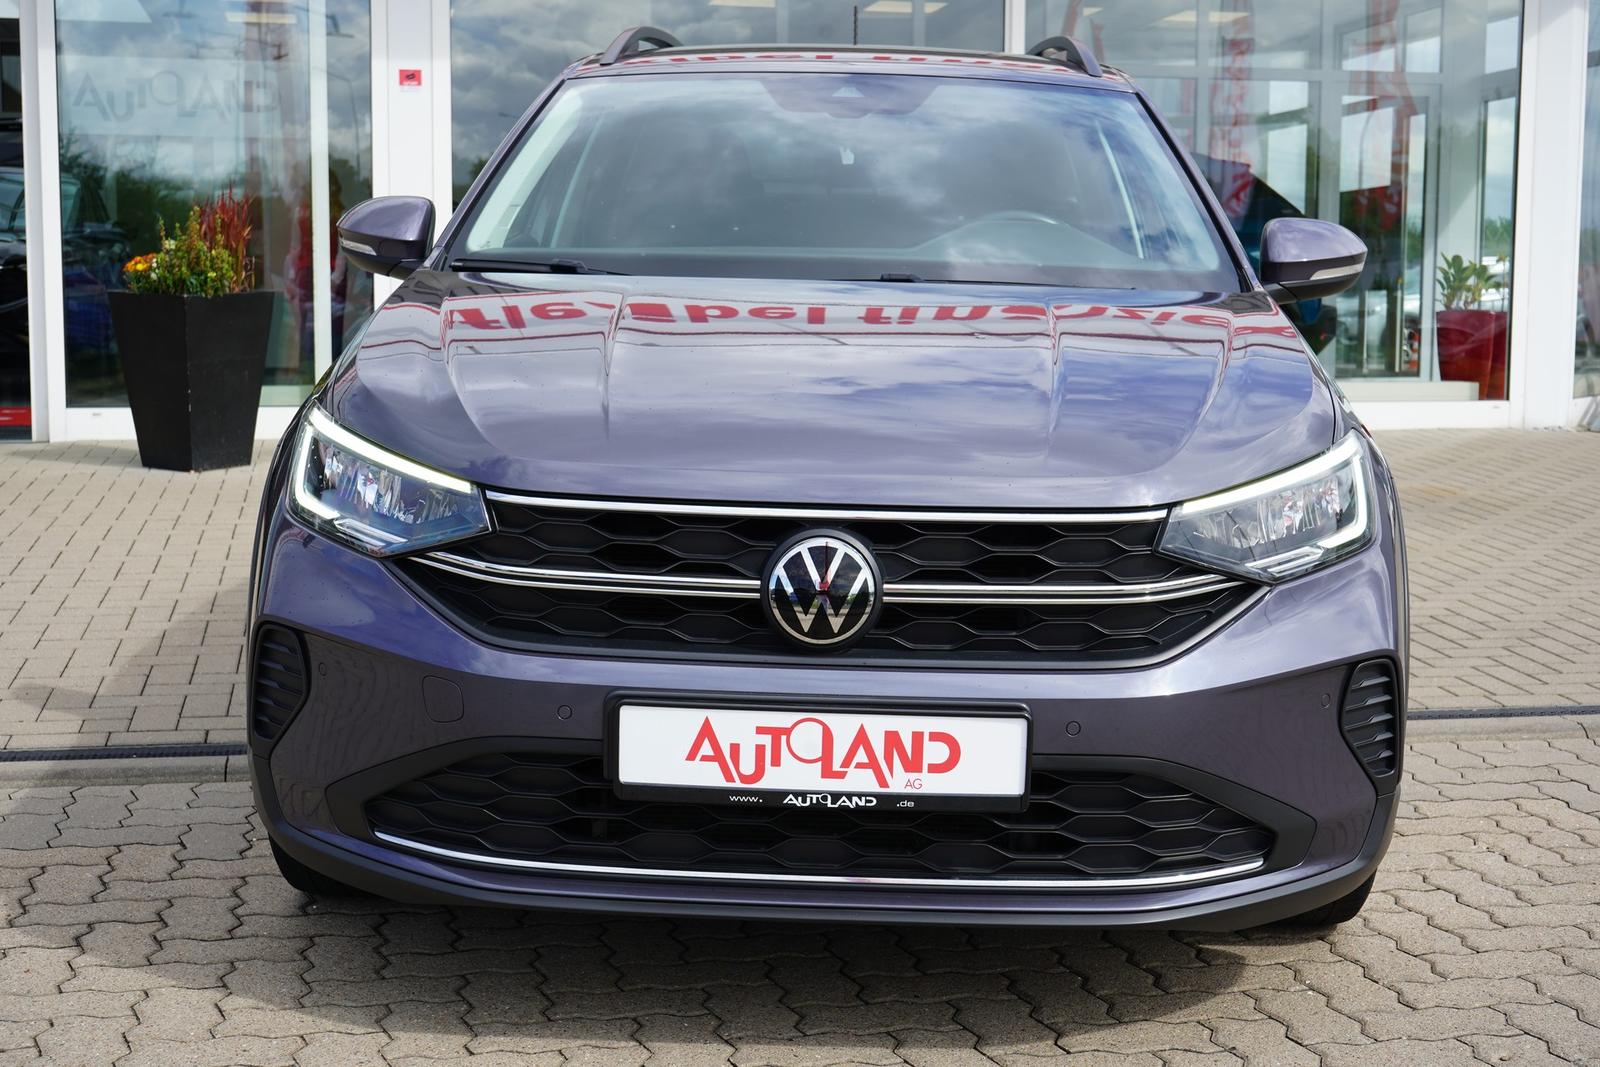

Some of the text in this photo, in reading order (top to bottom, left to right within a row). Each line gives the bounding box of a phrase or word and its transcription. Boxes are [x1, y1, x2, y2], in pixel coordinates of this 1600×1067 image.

[685, 716, 961, 788] AUTOLAND
[904, 778, 923, 790] AG
[729, 794, 763, 803] www.
[783, 793, 877, 808] AUTOLAND
